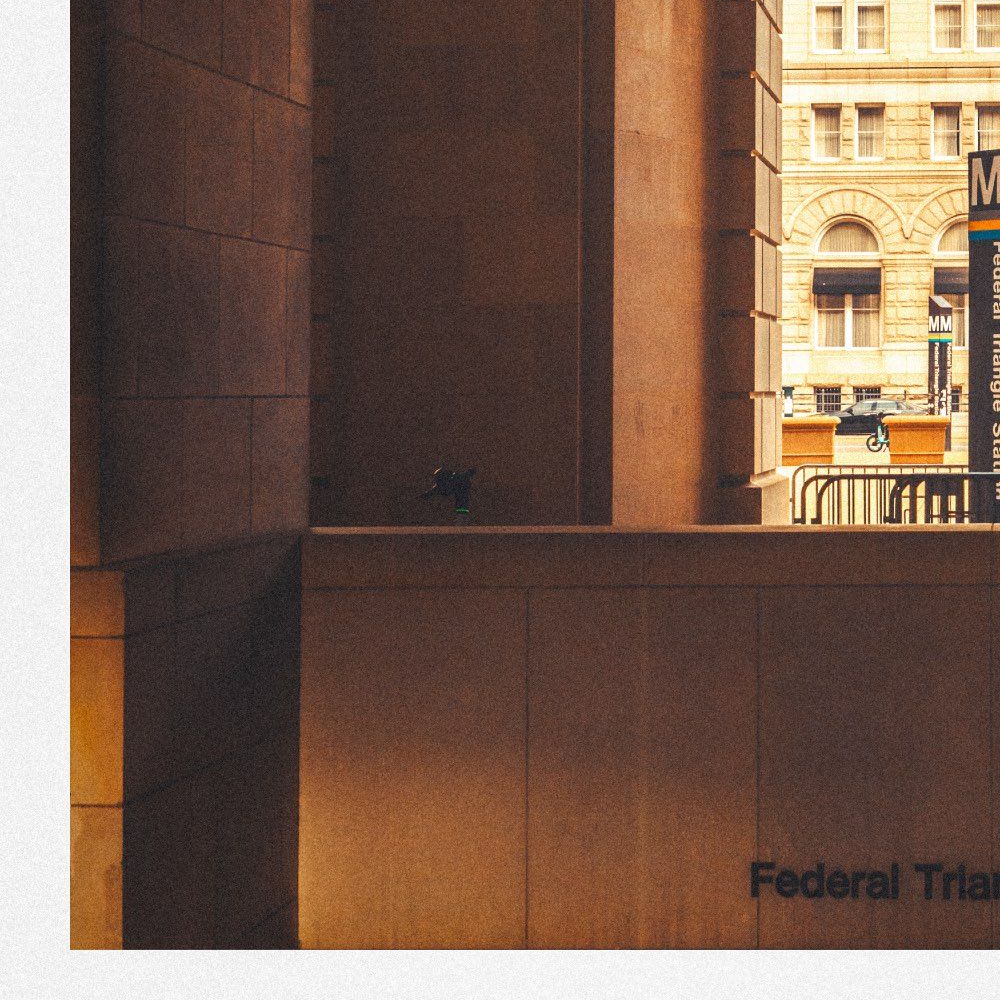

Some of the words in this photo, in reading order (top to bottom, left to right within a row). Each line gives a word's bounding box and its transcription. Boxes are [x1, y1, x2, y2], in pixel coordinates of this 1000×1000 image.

[929, 315, 939, 332] M
[940, 315, 952, 332] M
[750, 861, 898, 900] Federal
